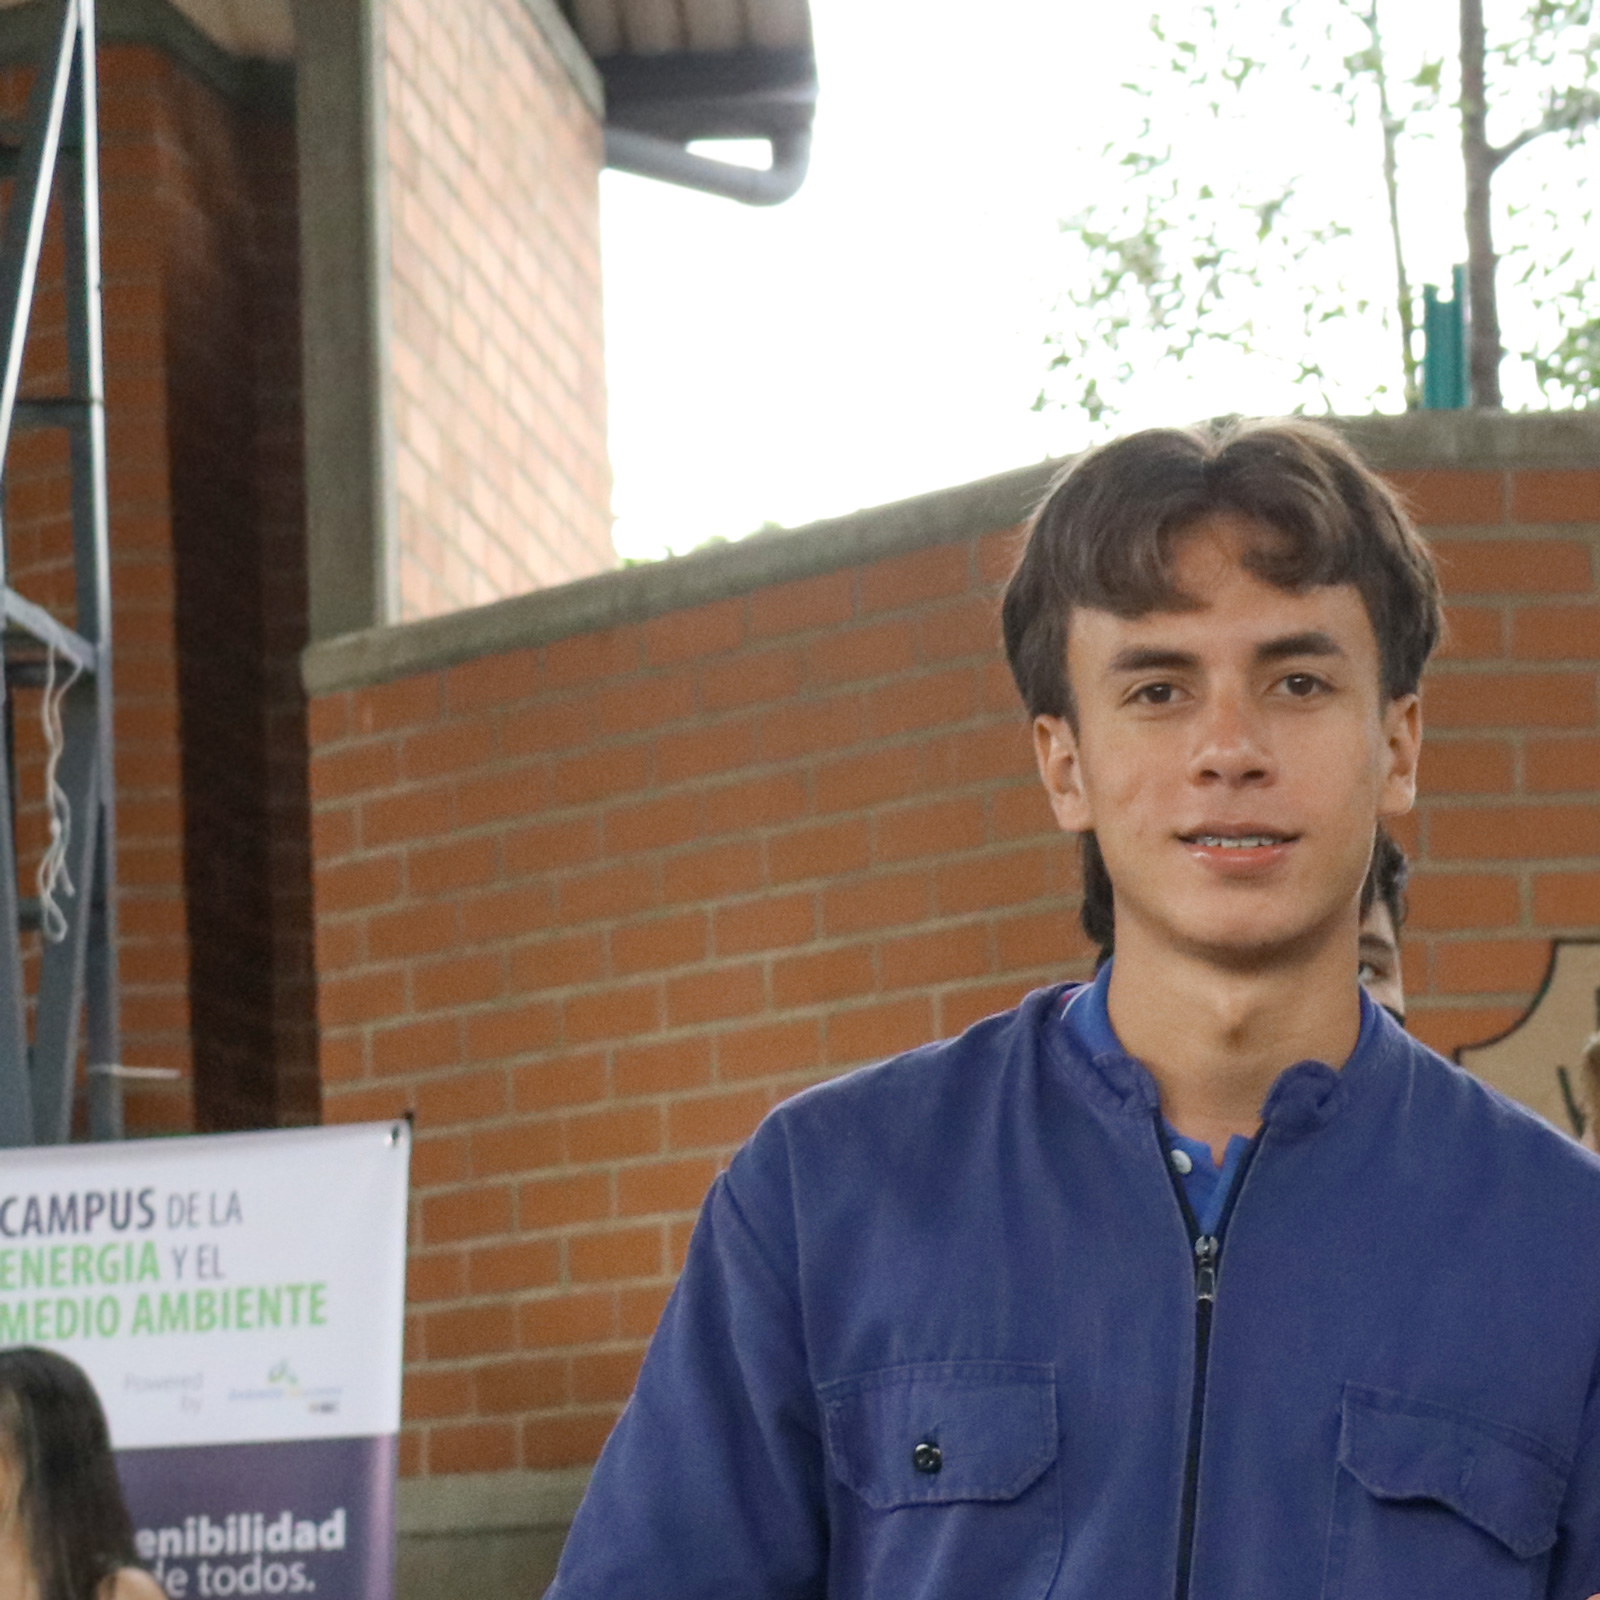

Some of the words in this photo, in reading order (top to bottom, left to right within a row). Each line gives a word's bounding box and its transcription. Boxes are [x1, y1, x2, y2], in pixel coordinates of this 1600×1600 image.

[0, 1188, 156, 1238] CAMPUS
[167, 1192, 199, 1229] DE
[209, 1190, 243, 1227] LA
[172, 1245, 188, 1280] Y
[196, 1244, 226, 1280] EL
[0, 1294, 121, 1342] MEDIO
[132, 1281, 327, 1335] AMBIENTE
[135, 1507, 346, 1559] enibilidad
[198, 1554, 315, 1596] todos.
